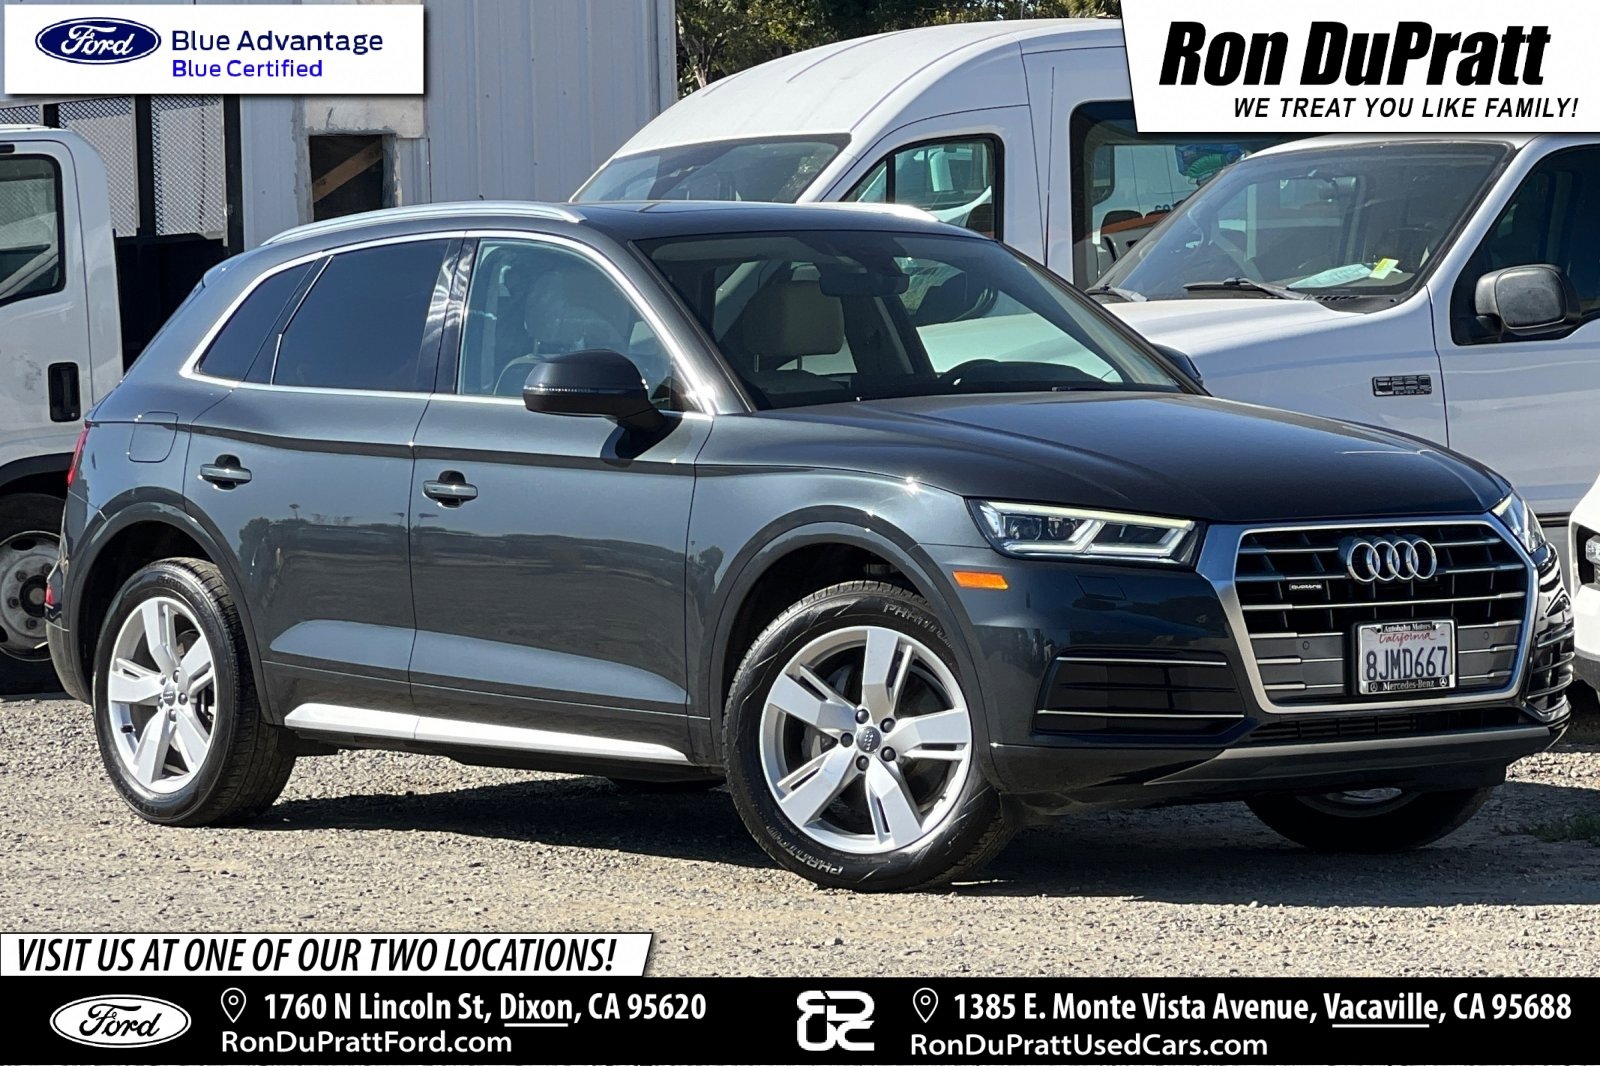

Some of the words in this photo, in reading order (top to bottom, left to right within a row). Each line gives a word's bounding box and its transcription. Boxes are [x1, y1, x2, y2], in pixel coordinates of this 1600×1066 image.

[1412, 622, 1432, 631] Motors
[1378, 632, 1435, 646] California
[1366, 646, 1447, 681] 8JMD667
[1382, 680, 1434, 691] Mercedes-Benz
